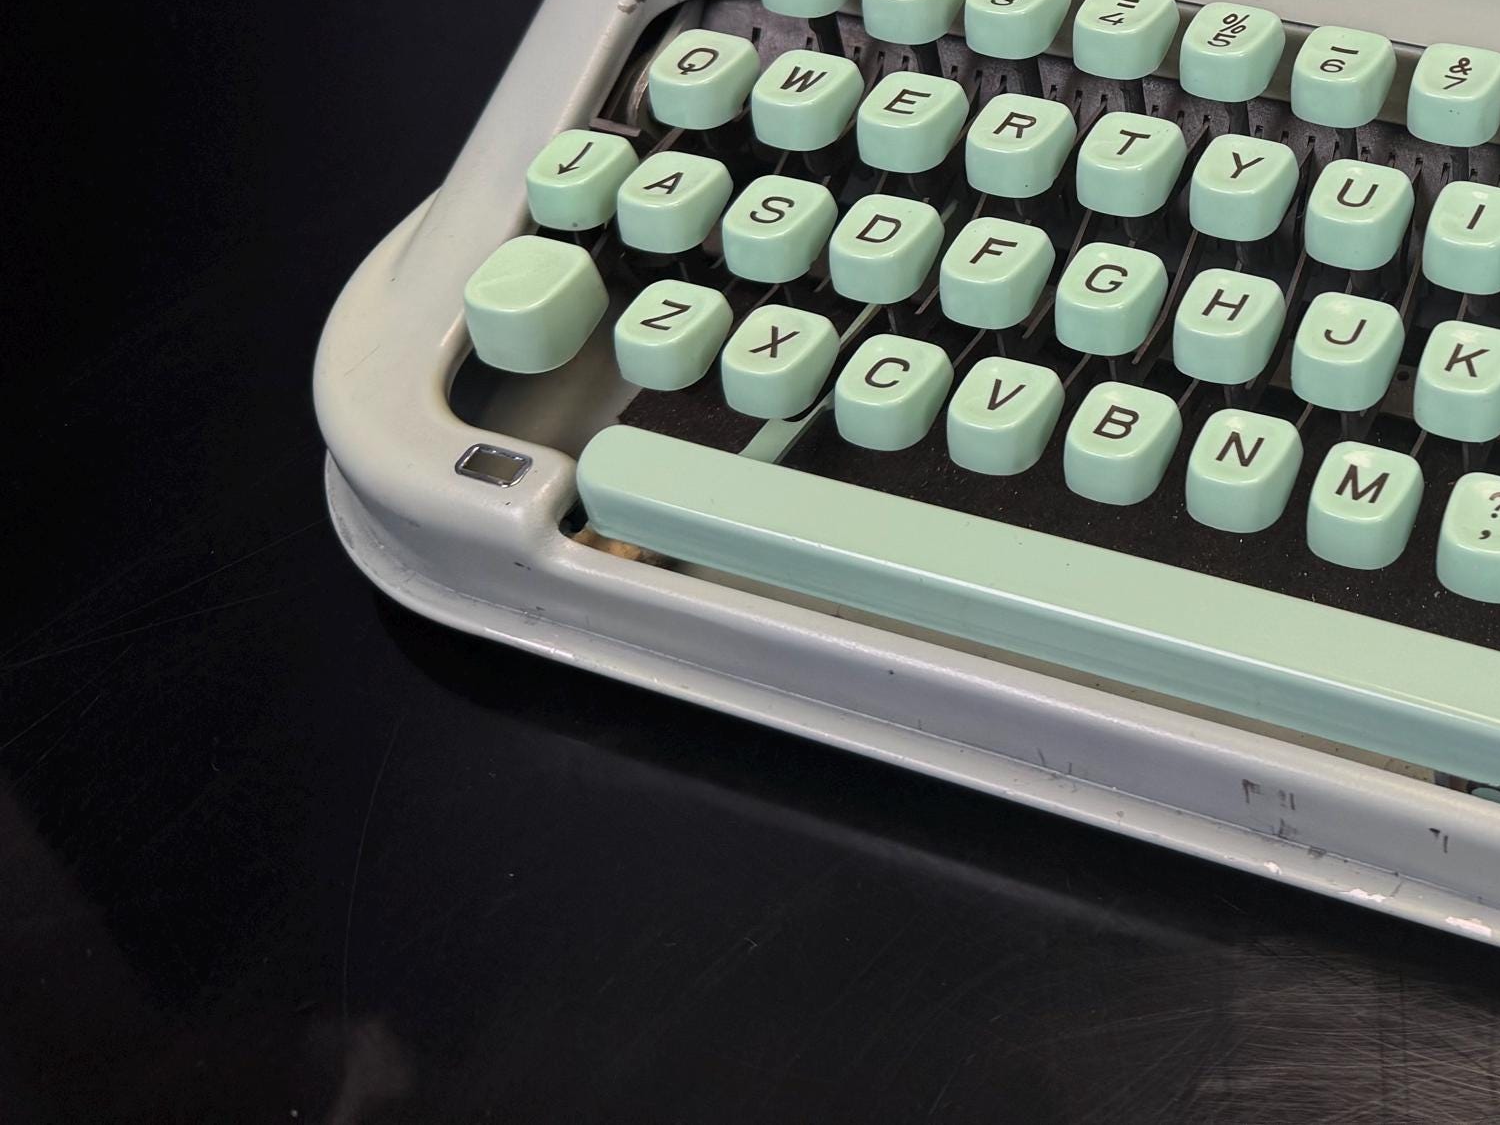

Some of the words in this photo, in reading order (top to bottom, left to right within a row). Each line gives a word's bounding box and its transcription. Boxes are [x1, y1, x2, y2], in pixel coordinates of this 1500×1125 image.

[1099, 13, 1124, 25] 4
[1219, 14, 1250, 34] %
[1207, 33, 1236, 47] 5
[677, 48, 719, 75] Q
[1320, 59, 1345, 73] 6
[1449, 58, 1472, 75] &
[780, 66, 827, 92] W
[1443, 75, 1467, 90] 7
[883, 89, 931, 114] E
[993, 112, 1036, 138] R
[1117, 130, 1151, 155] T
[1230, 152, 1264, 179] Y
[643, 172, 683, 194] A
[1337, 178, 1379, 207] U
[750, 197, 795, 223] S
[1466, 204, 1485, 230] I
[856, 214, 901, 243] D
[969, 237, 1017, 264] F
[1085, 264, 1128, 293] G
[640, 299, 691, 330] Z
[1202, 289, 1249, 321] H
[749, 326, 800, 358] X
[1324, 319, 1367, 345] J
[865, 357, 910, 388] C
[1444, 343, 1490, 377] K
[987, 379, 1026, 410] V
[1093, 405, 1139, 439] B
[1216, 431, 1264, 467] N
[1335, 464, 1390, 503] M
